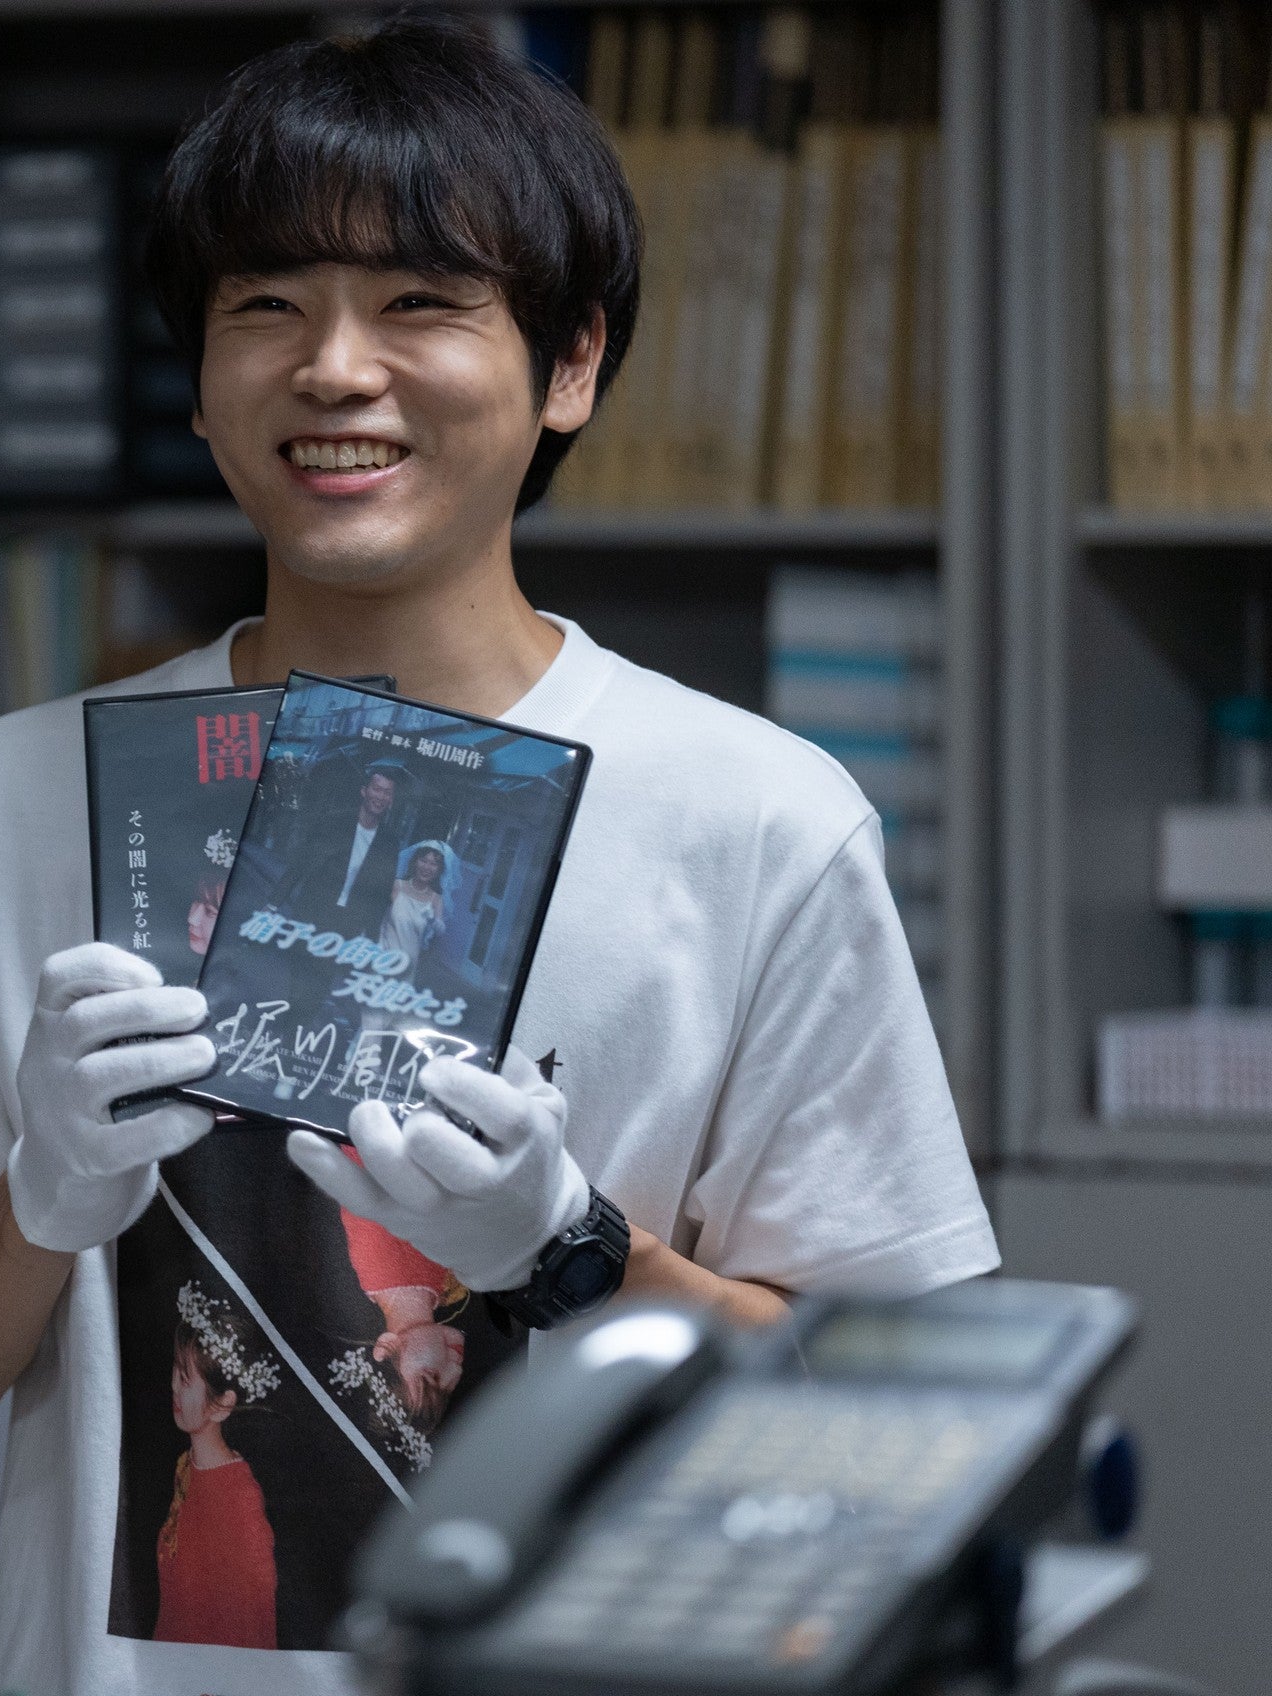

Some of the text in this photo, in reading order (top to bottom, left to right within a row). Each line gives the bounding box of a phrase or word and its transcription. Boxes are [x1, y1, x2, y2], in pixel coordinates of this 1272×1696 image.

[195, 711, 262, 785] 闇
[416, 737, 486, 770] 堀川周作
[128, 809, 152, 950] その闇に光る紅
[332, 970, 468, 1027] 天使たち
